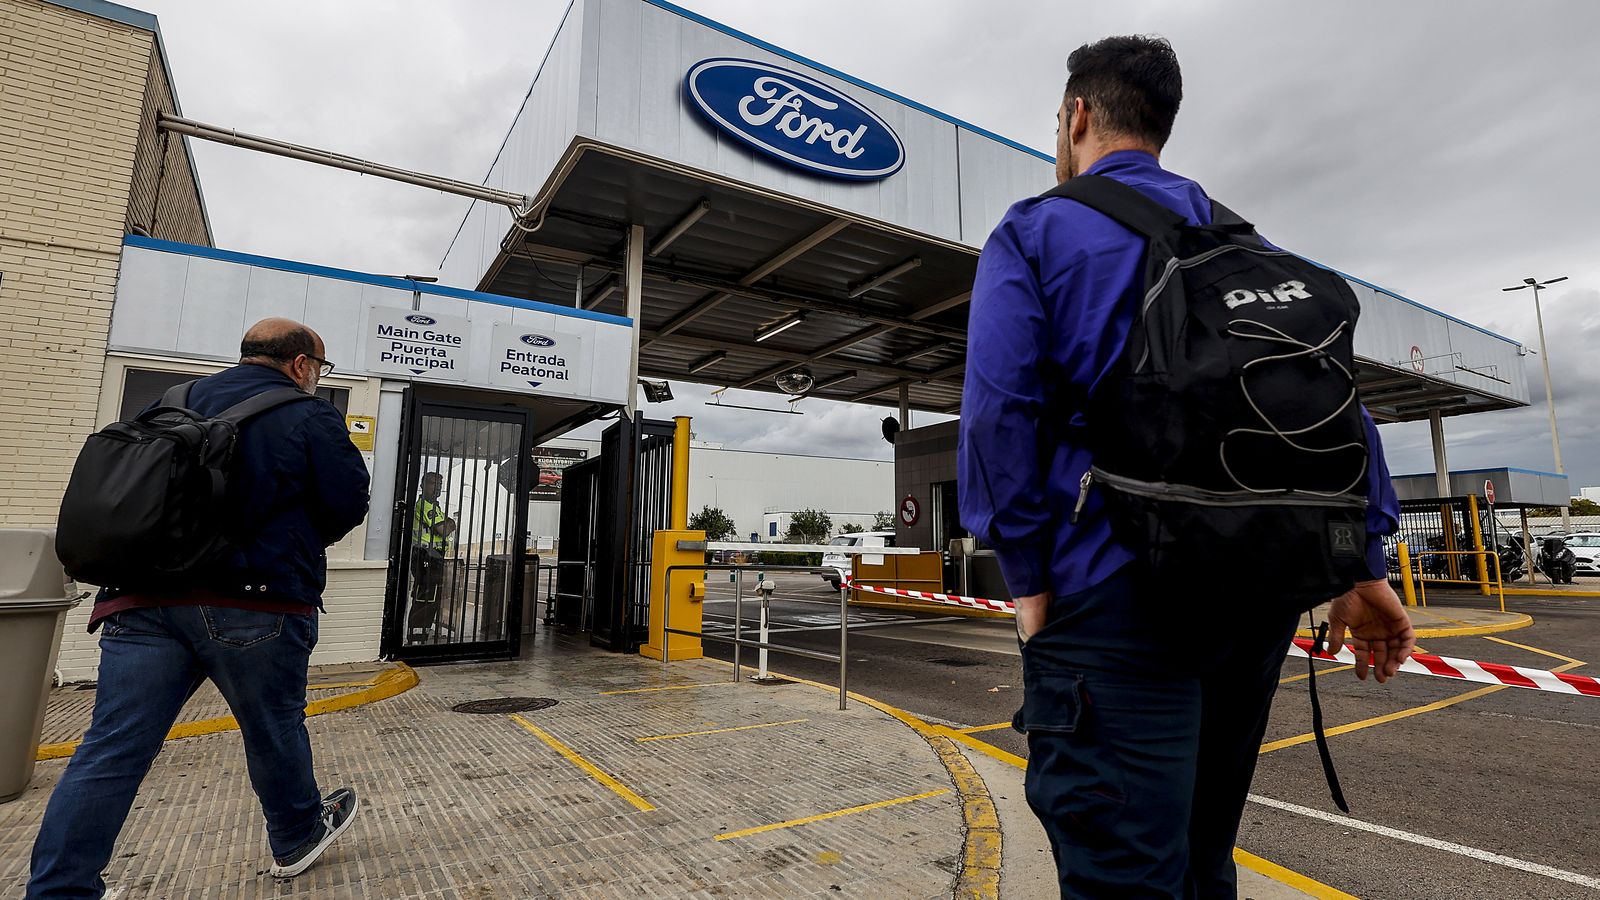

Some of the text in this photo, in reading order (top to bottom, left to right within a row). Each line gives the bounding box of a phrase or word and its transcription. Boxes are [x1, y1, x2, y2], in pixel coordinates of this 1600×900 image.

[739, 77, 867, 159] Ford
[411, 315, 431, 324] Ford
[378, 325, 461, 344] Main Gate
[527, 335, 549, 346] Ford
[391, 342, 447, 357] Puerta
[506, 349, 565, 366] Entrada
[381, 352, 454, 369] Principal
[500, 362, 568, 380] Peatonal
